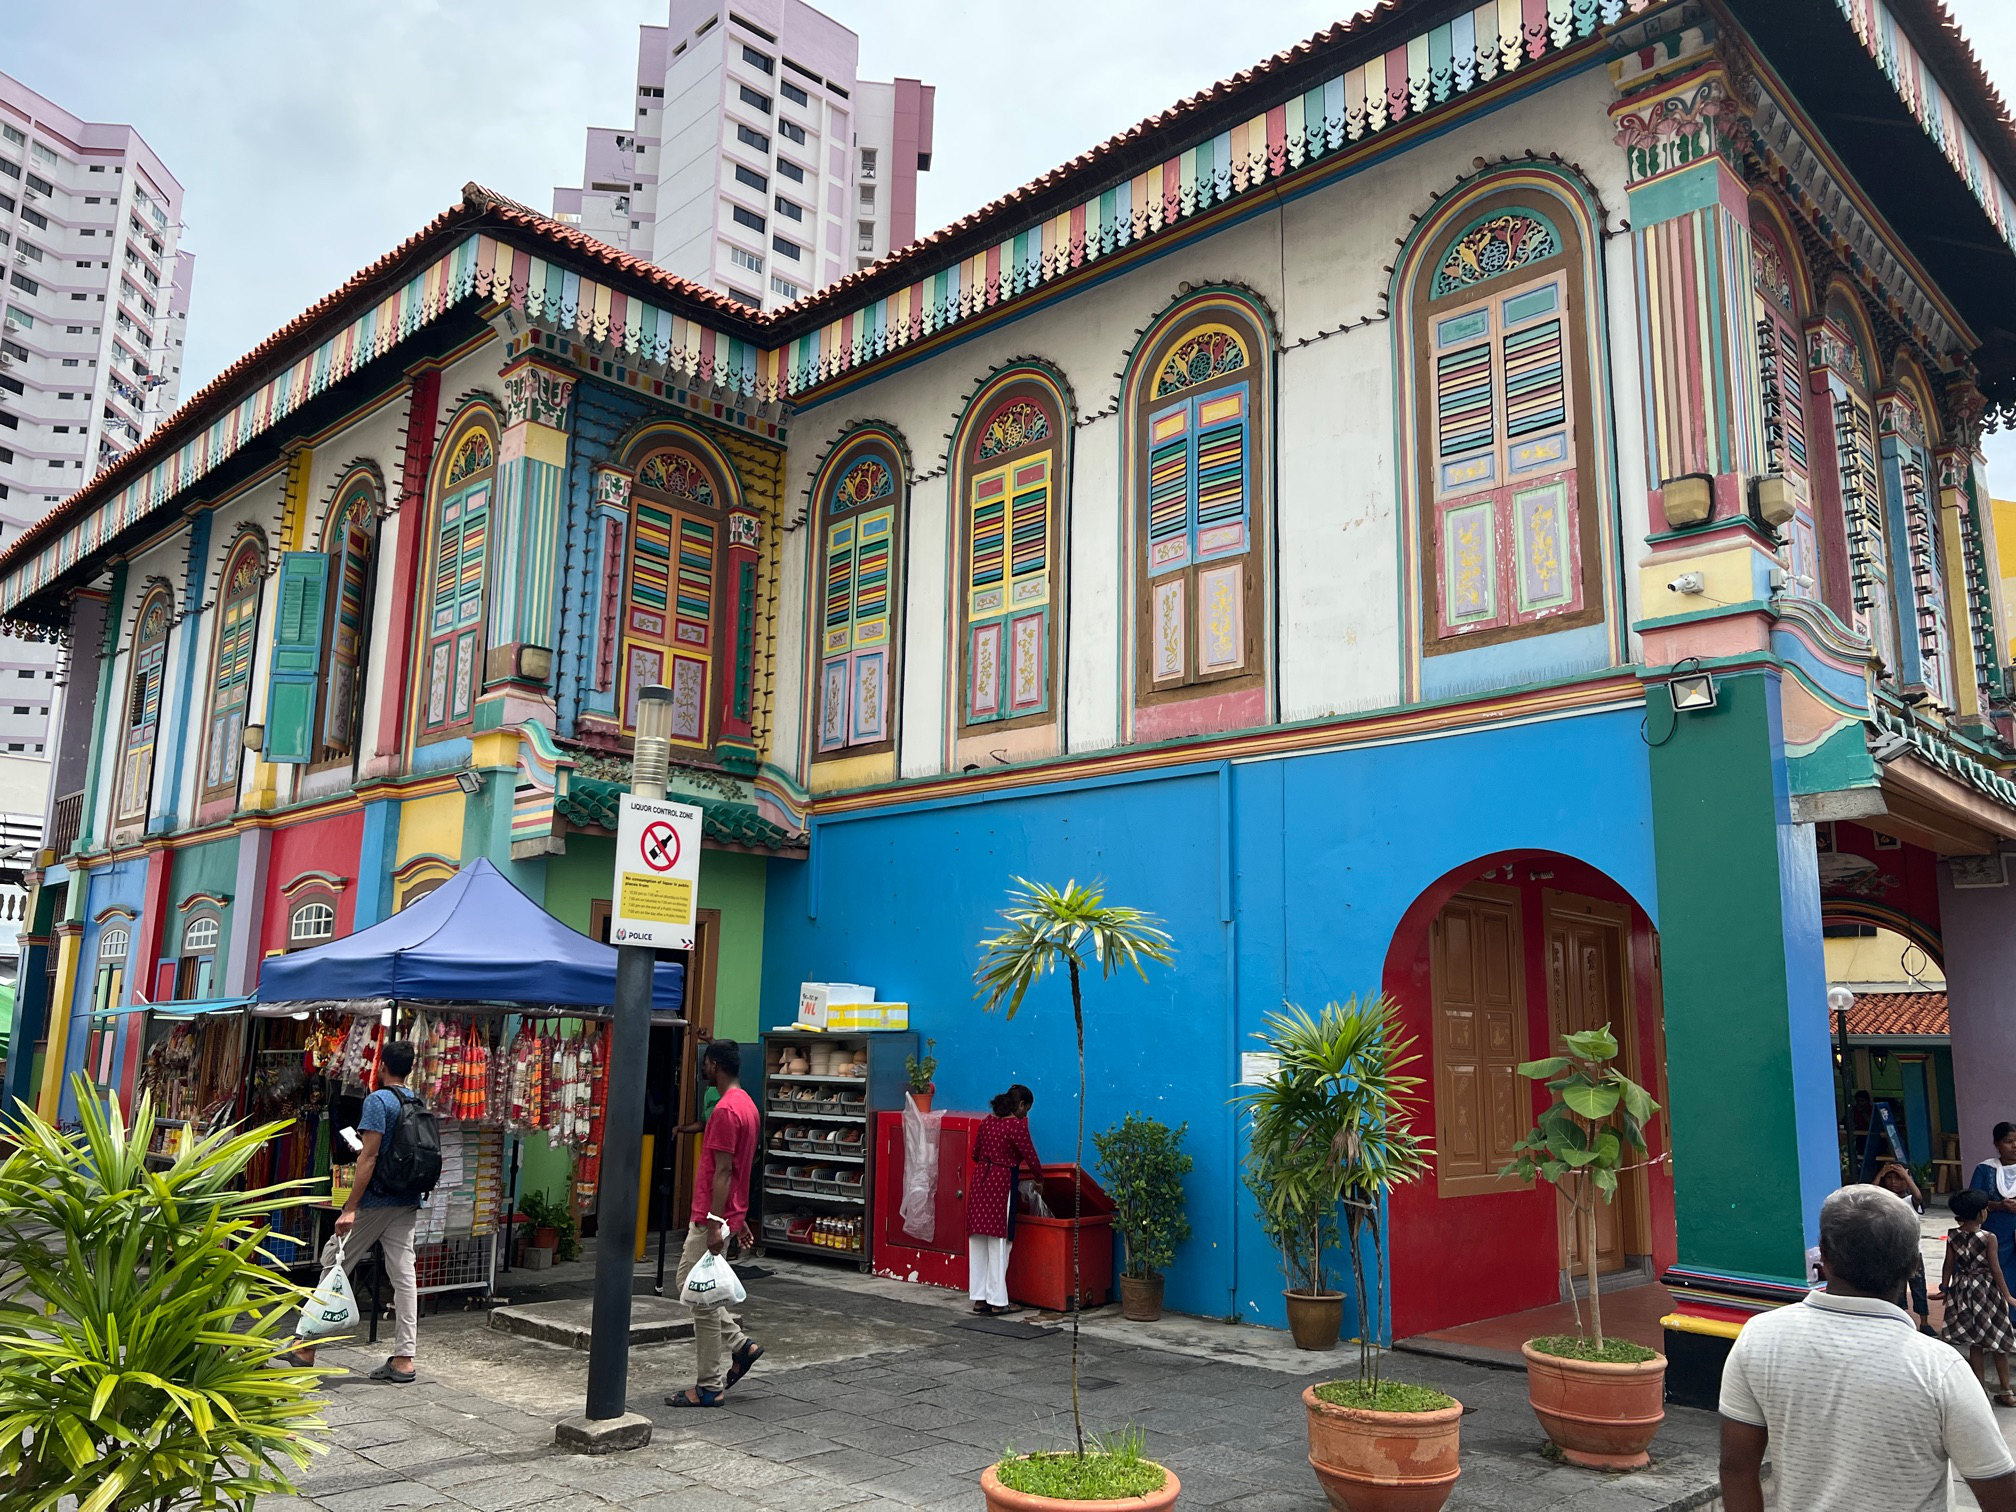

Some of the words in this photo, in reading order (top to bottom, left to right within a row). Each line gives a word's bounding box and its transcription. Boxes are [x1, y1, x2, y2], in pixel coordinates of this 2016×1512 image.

[630, 802, 652, 812] LIQUOR
[653, 806, 678, 817] CONTROL
[679, 811, 694, 820] ZONE
[628, 932, 653, 940] POLICE
